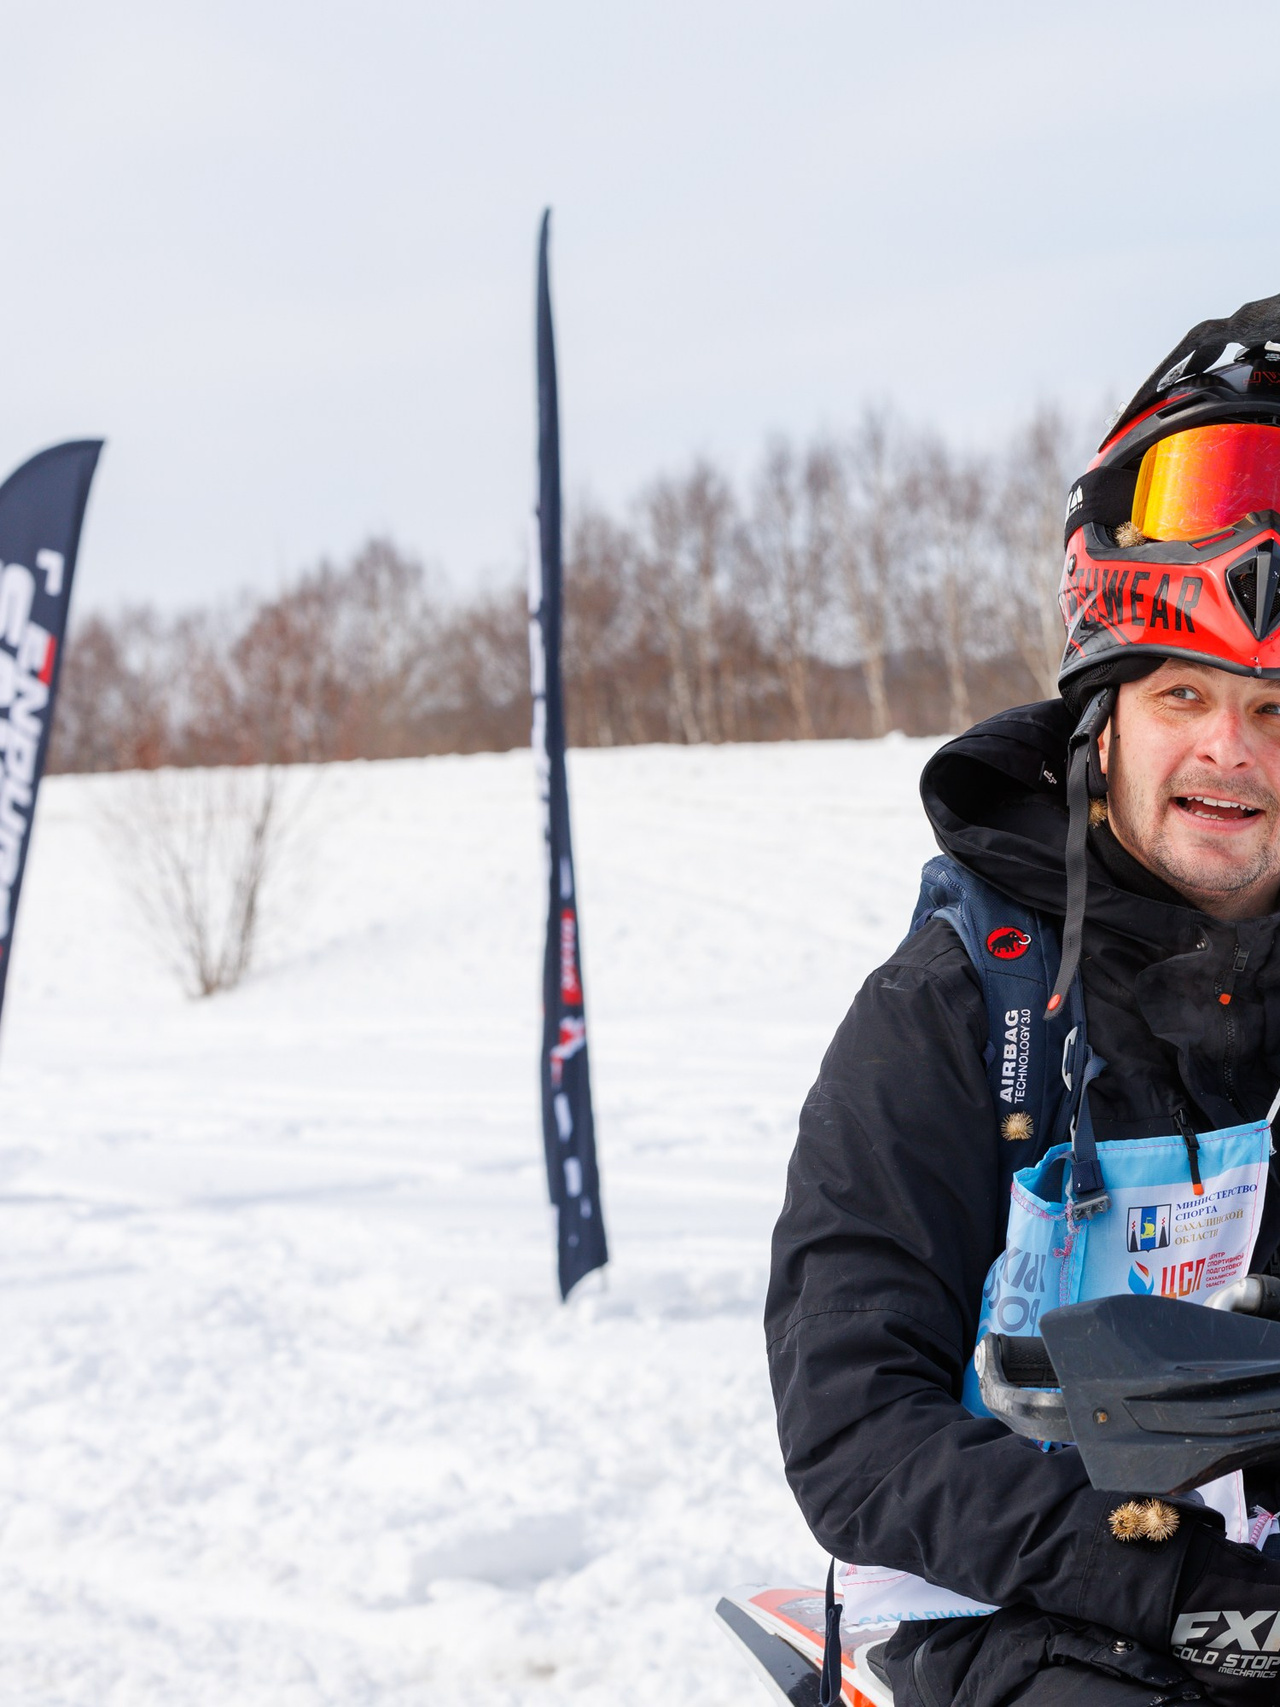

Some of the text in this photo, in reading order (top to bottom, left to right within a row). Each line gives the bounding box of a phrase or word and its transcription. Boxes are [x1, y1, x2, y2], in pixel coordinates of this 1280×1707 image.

[1000, 1010, 1019, 1103] AIRBAG
[1014, 1009, 1031, 1104] TECHNOLOGY 3.0
[1176, 1205, 1218, 1221] СПОРТА
[1161, 1257, 1206, 1300] ЦСП
[1172, 1645, 1219, 1665] COLD
[1218, 1666, 1278, 1679] MECHANICS
